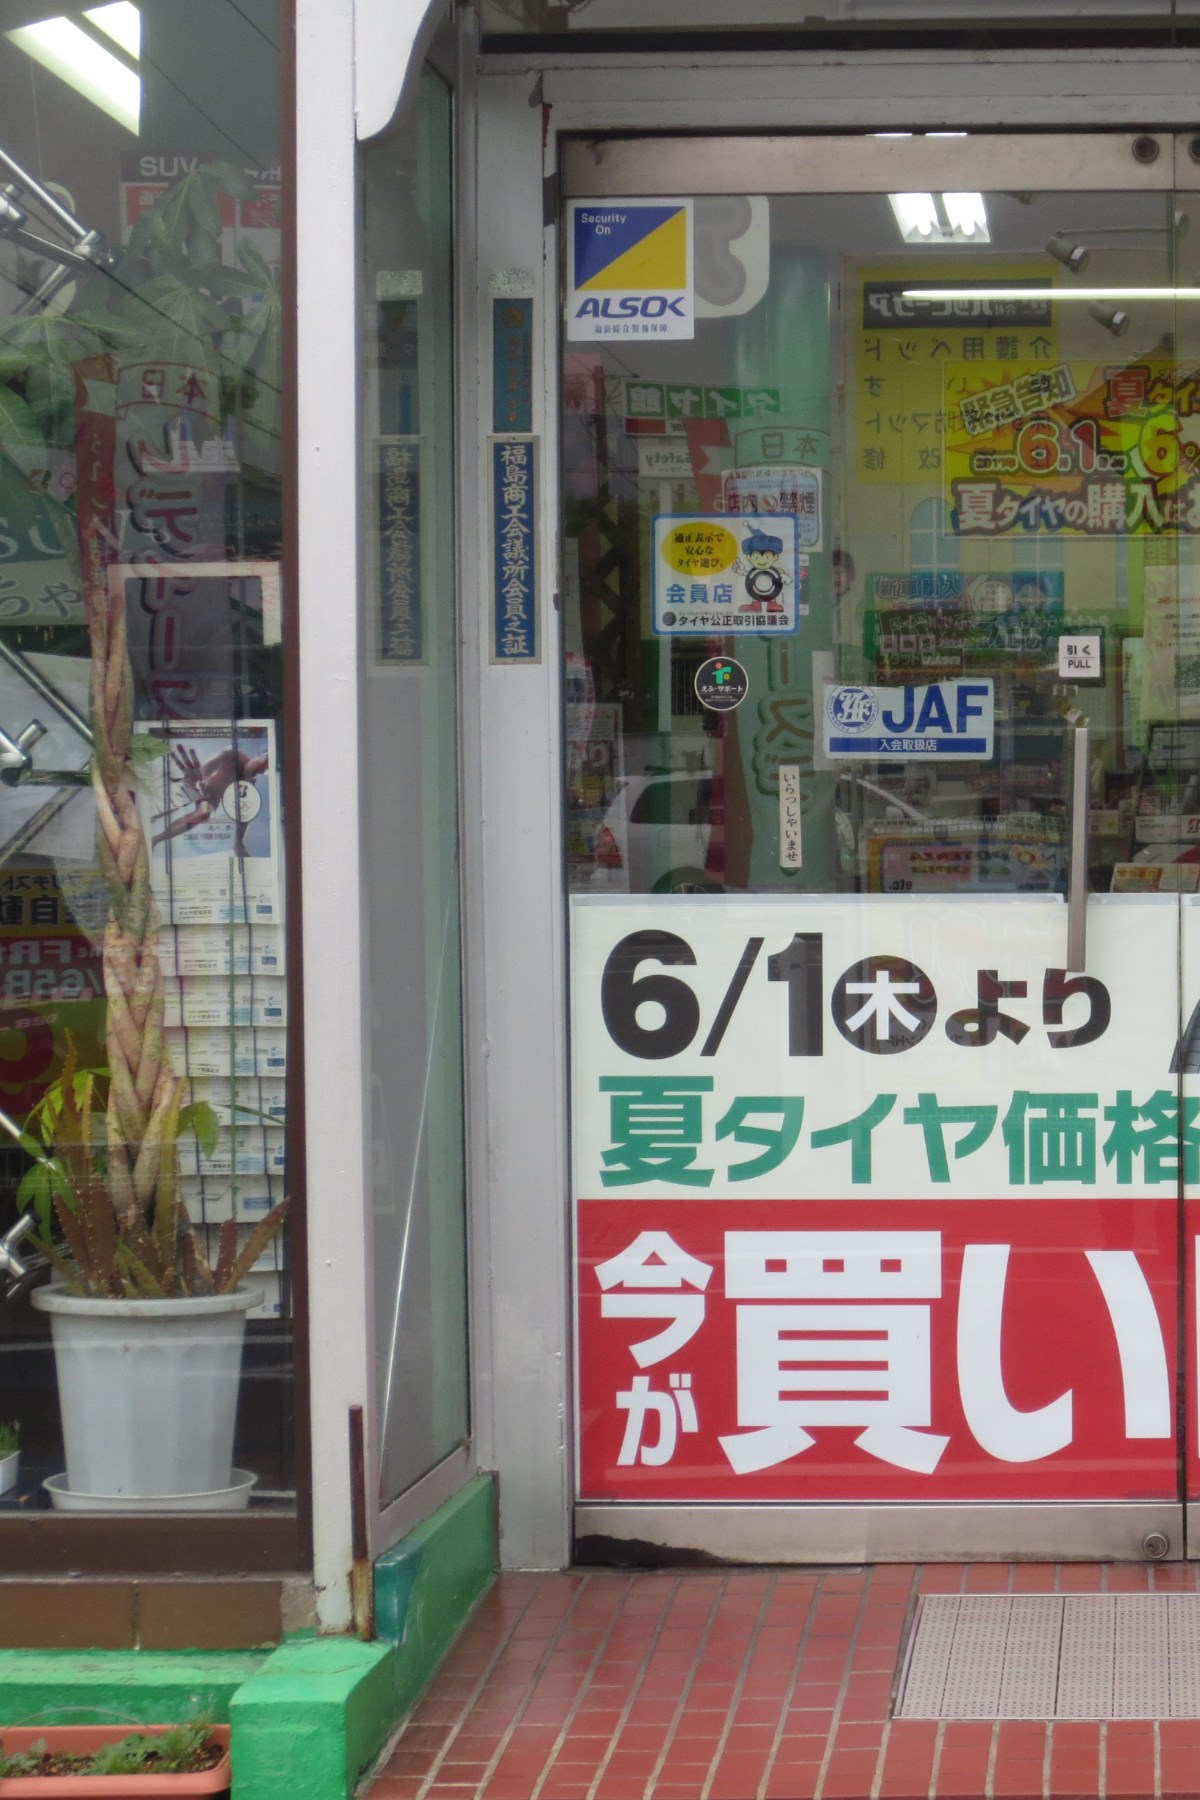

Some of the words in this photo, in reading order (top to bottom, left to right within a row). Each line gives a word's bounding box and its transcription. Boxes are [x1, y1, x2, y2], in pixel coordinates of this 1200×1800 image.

[581, 213, 627, 224] Security
[595, 225, 611, 235] On
[575, 296, 686, 318] ALSOK
[501, 444, 531, 656] 福島商工会議所会員之証
[666, 584, 733, 604] 会員店
[678, 615, 789, 626] タイヤ公正取引協議会
[1067, 645, 1091, 656] 引く
[1068, 660, 1091, 669] PULL
[882, 685, 989, 733] JAF
[879, 739, 937, 751] 入会取扱店
